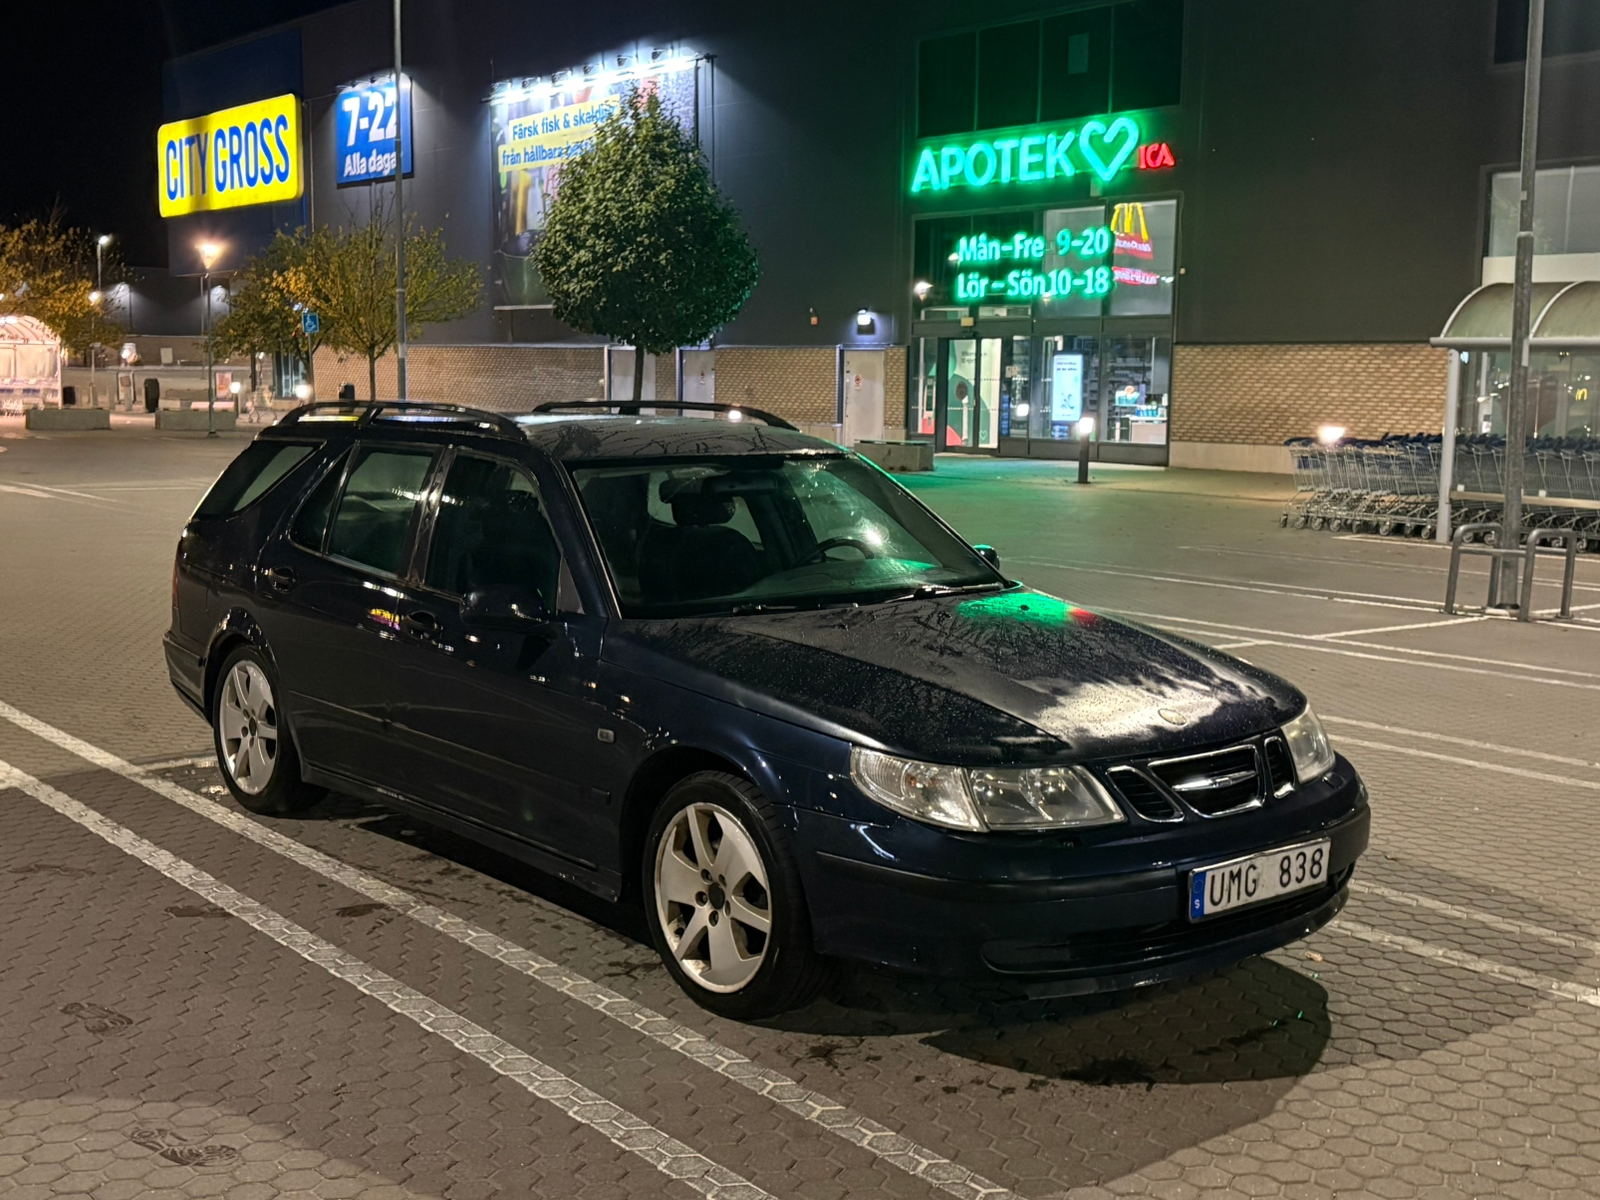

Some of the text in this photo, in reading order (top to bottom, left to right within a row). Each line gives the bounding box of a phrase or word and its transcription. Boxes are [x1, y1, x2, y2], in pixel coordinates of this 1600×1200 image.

[512, 120, 539, 141] Färsk
[541, 114, 561, 134] fisk
[562, 111, 571, 129] &
[165, 114, 290, 201] CITY GROSS
[343, 148, 400, 177] Alla daga
[502, 147, 522, 166] från
[911, 130, 1177, 193] APOTEK ICA
[1056, 227, 1110, 256] 9-20
[1049, 266, 1110, 295] 10-18
[1209, 848, 1324, 906] UMG 838
[1194, 899, 1200, 909] S
